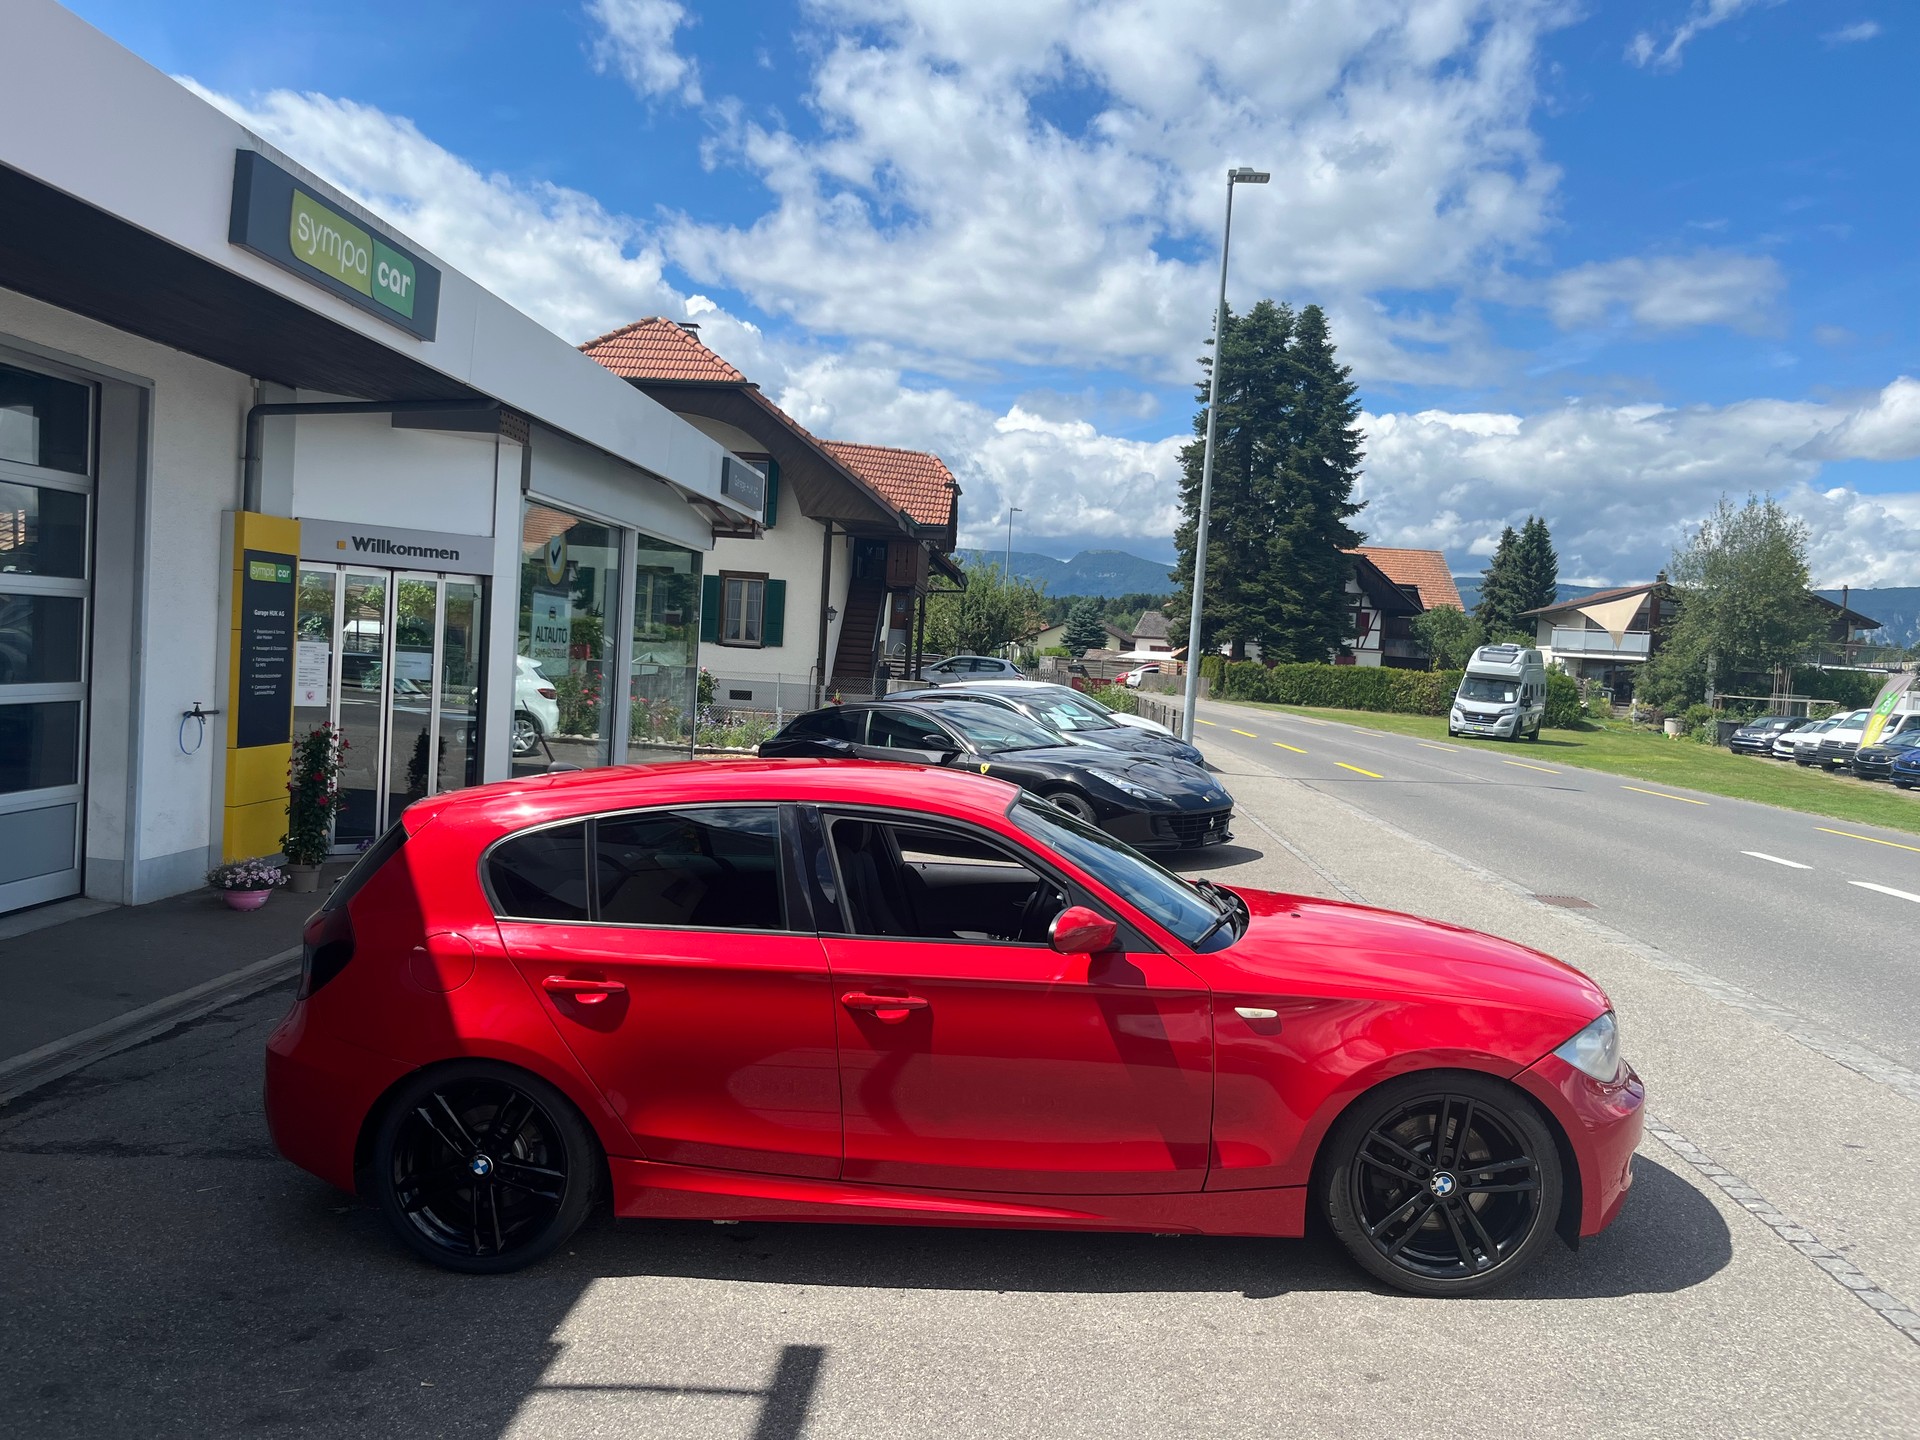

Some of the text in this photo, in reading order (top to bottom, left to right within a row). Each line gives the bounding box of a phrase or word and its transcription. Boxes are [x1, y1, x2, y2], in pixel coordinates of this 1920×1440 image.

[298, 212, 411, 298] sympa car
[351, 536, 460, 561] Willkommen
[251, 567, 290, 578] sympa car
[254, 609, 269, 617] Garage
[535, 626, 567, 643] ALTAUTO
